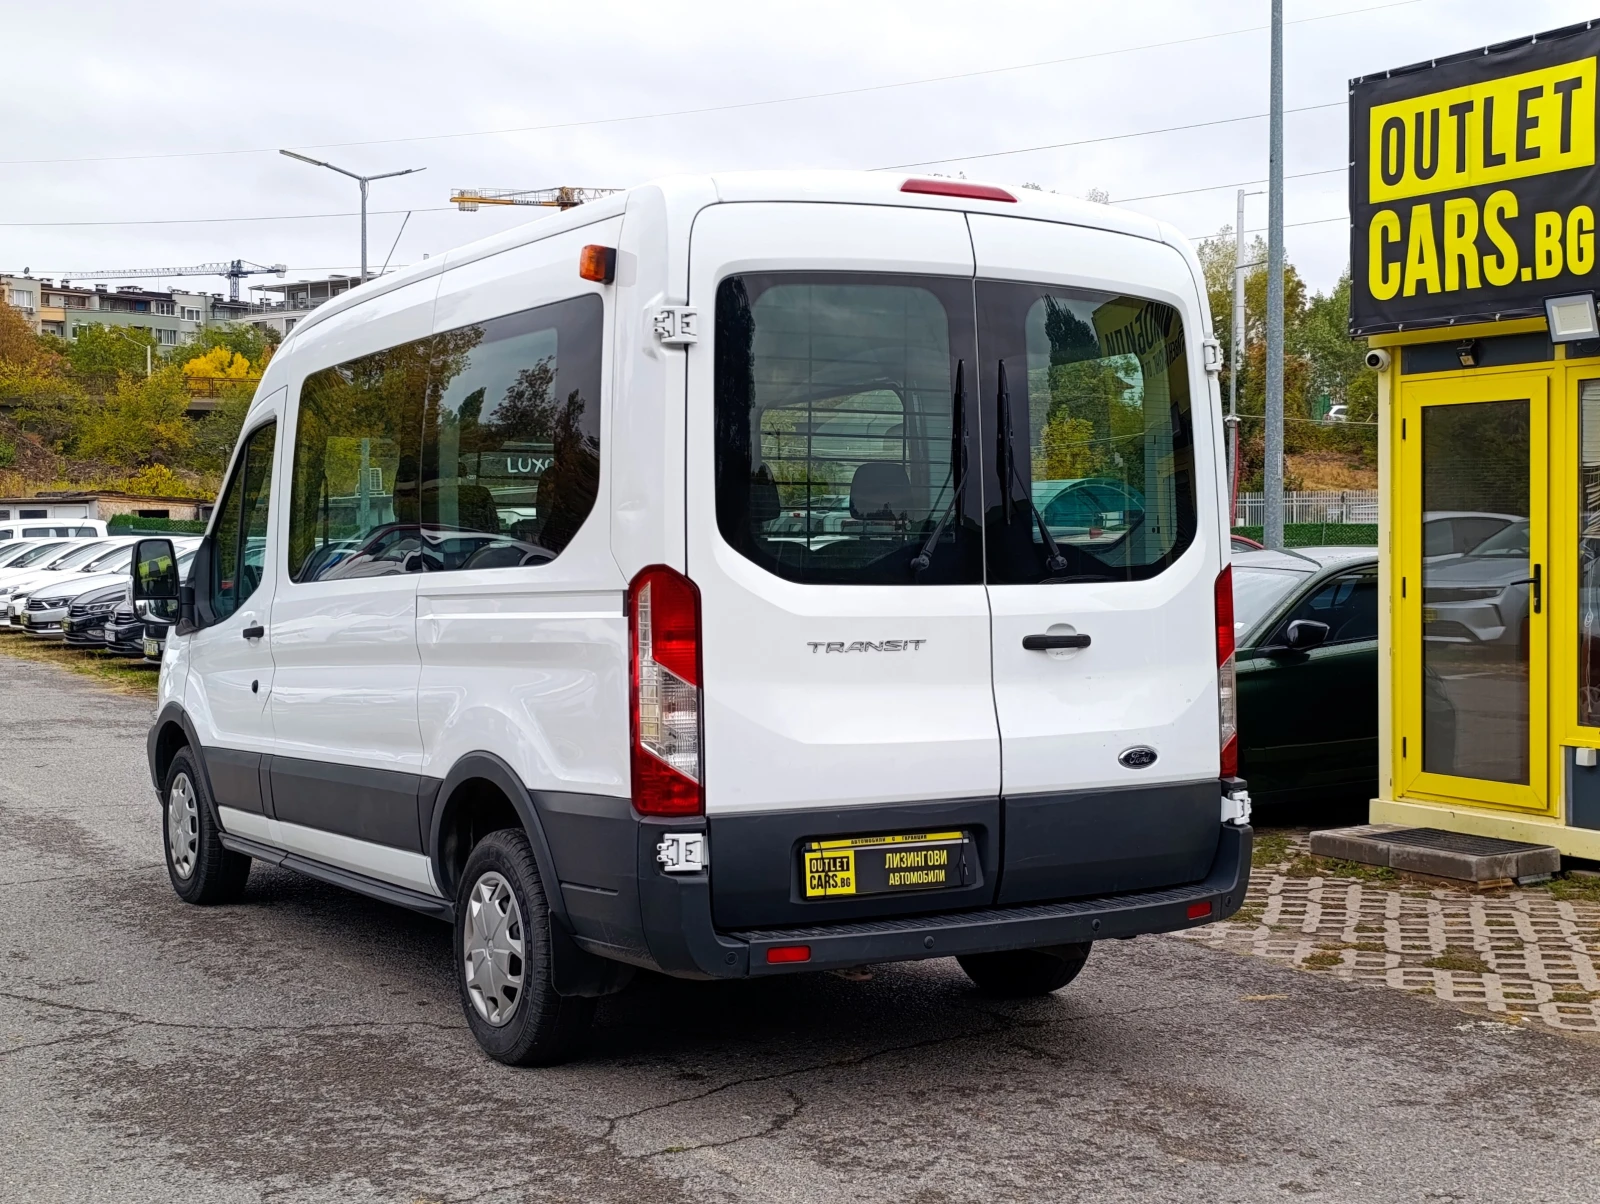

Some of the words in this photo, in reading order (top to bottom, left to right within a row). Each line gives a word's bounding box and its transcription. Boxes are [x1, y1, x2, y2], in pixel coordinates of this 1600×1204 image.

[1381, 76, 1582, 186] OUTLET
[1369, 190, 1595, 300] CARS.BG
[807, 639, 927, 653] TRANSIT
[811, 858, 848, 872] OUTLET
[885, 850, 947, 869] ЛИЗИНГОВИ
[888, 869, 946, 886] АВТОМОБИЛИ
